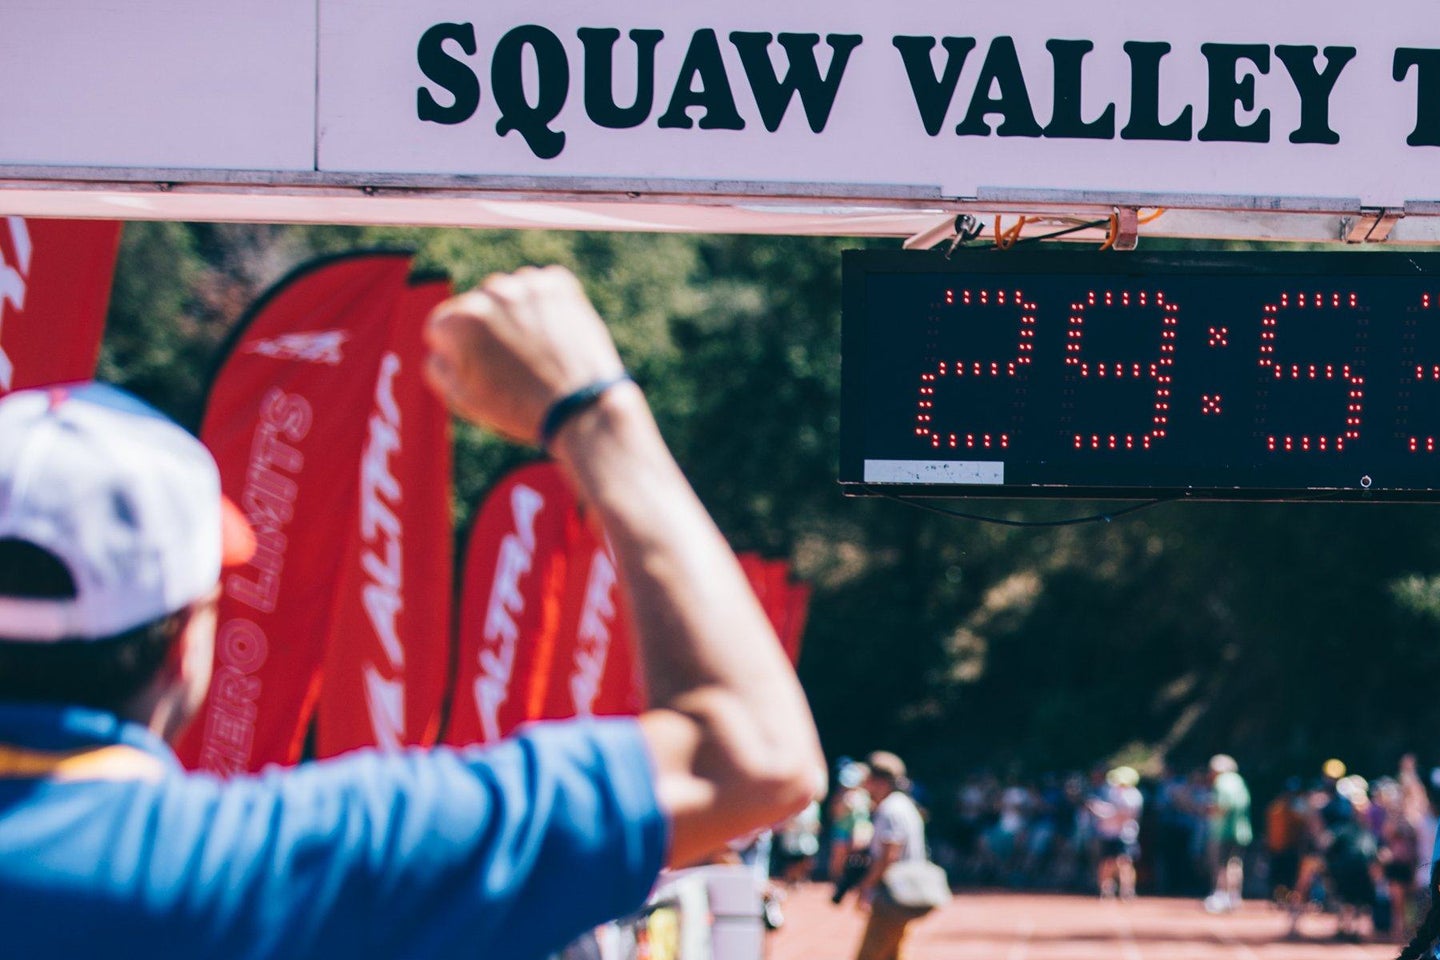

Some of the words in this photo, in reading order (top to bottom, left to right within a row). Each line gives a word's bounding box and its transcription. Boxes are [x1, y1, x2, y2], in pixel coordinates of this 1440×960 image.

[416, 22, 863, 159] SQUAW
[892, 35, 1357, 145] VALLEY
[225, 385, 312, 613] LIMITS
